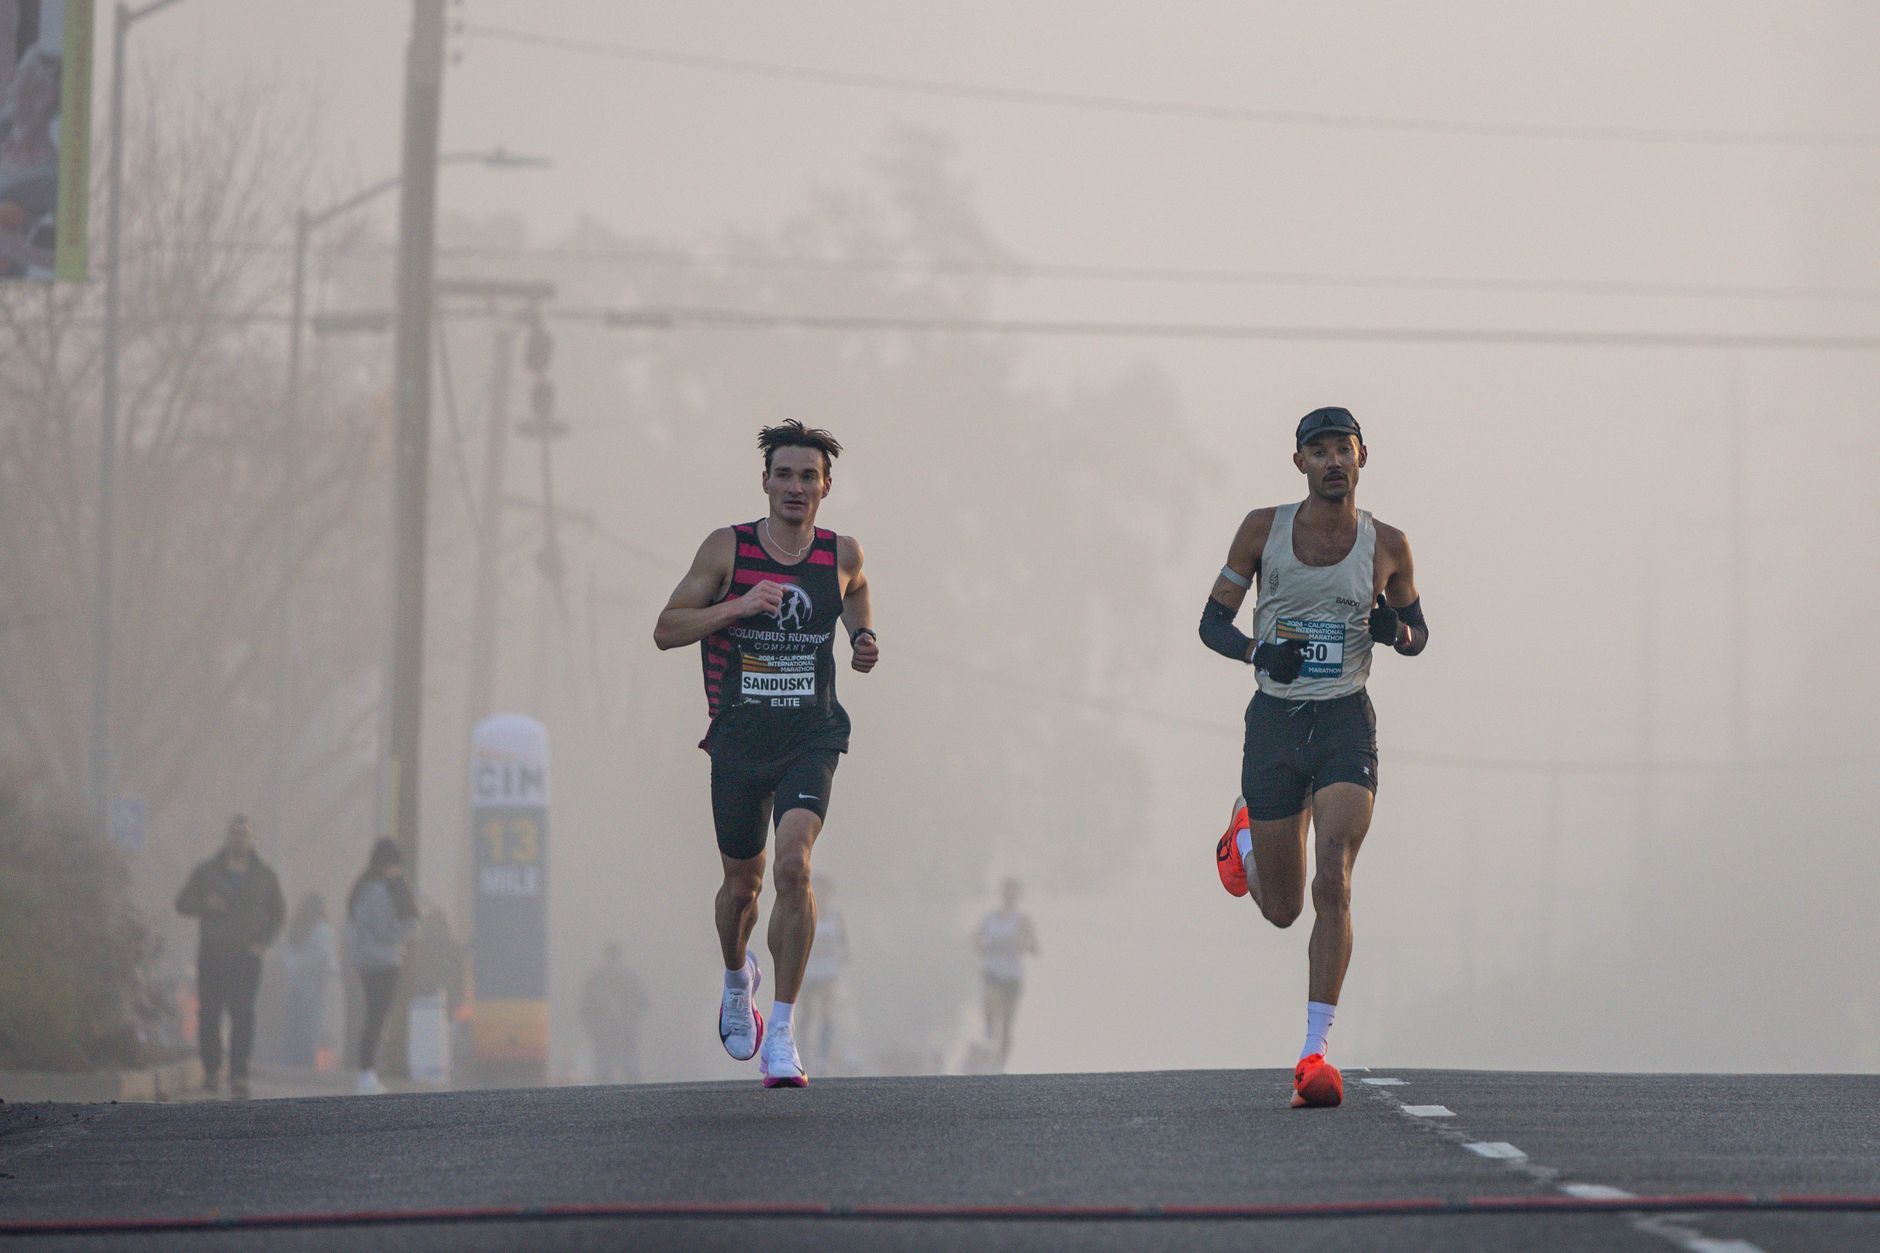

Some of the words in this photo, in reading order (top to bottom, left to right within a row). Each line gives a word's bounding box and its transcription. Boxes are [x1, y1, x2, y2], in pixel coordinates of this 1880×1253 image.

[1296, 627, 1344, 635] INTERNATIONAL
[1308, 622, 1345, 630] CALIFORNIA
[728, 627, 786, 642] COLUMBUS
[754, 642, 806, 652] COMPANY
[743, 676, 814, 691] SANDUSKY
[771, 698, 800, 707] ELITE
[481, 817, 538, 863] 13
[480, 867, 539, 895] MILE
